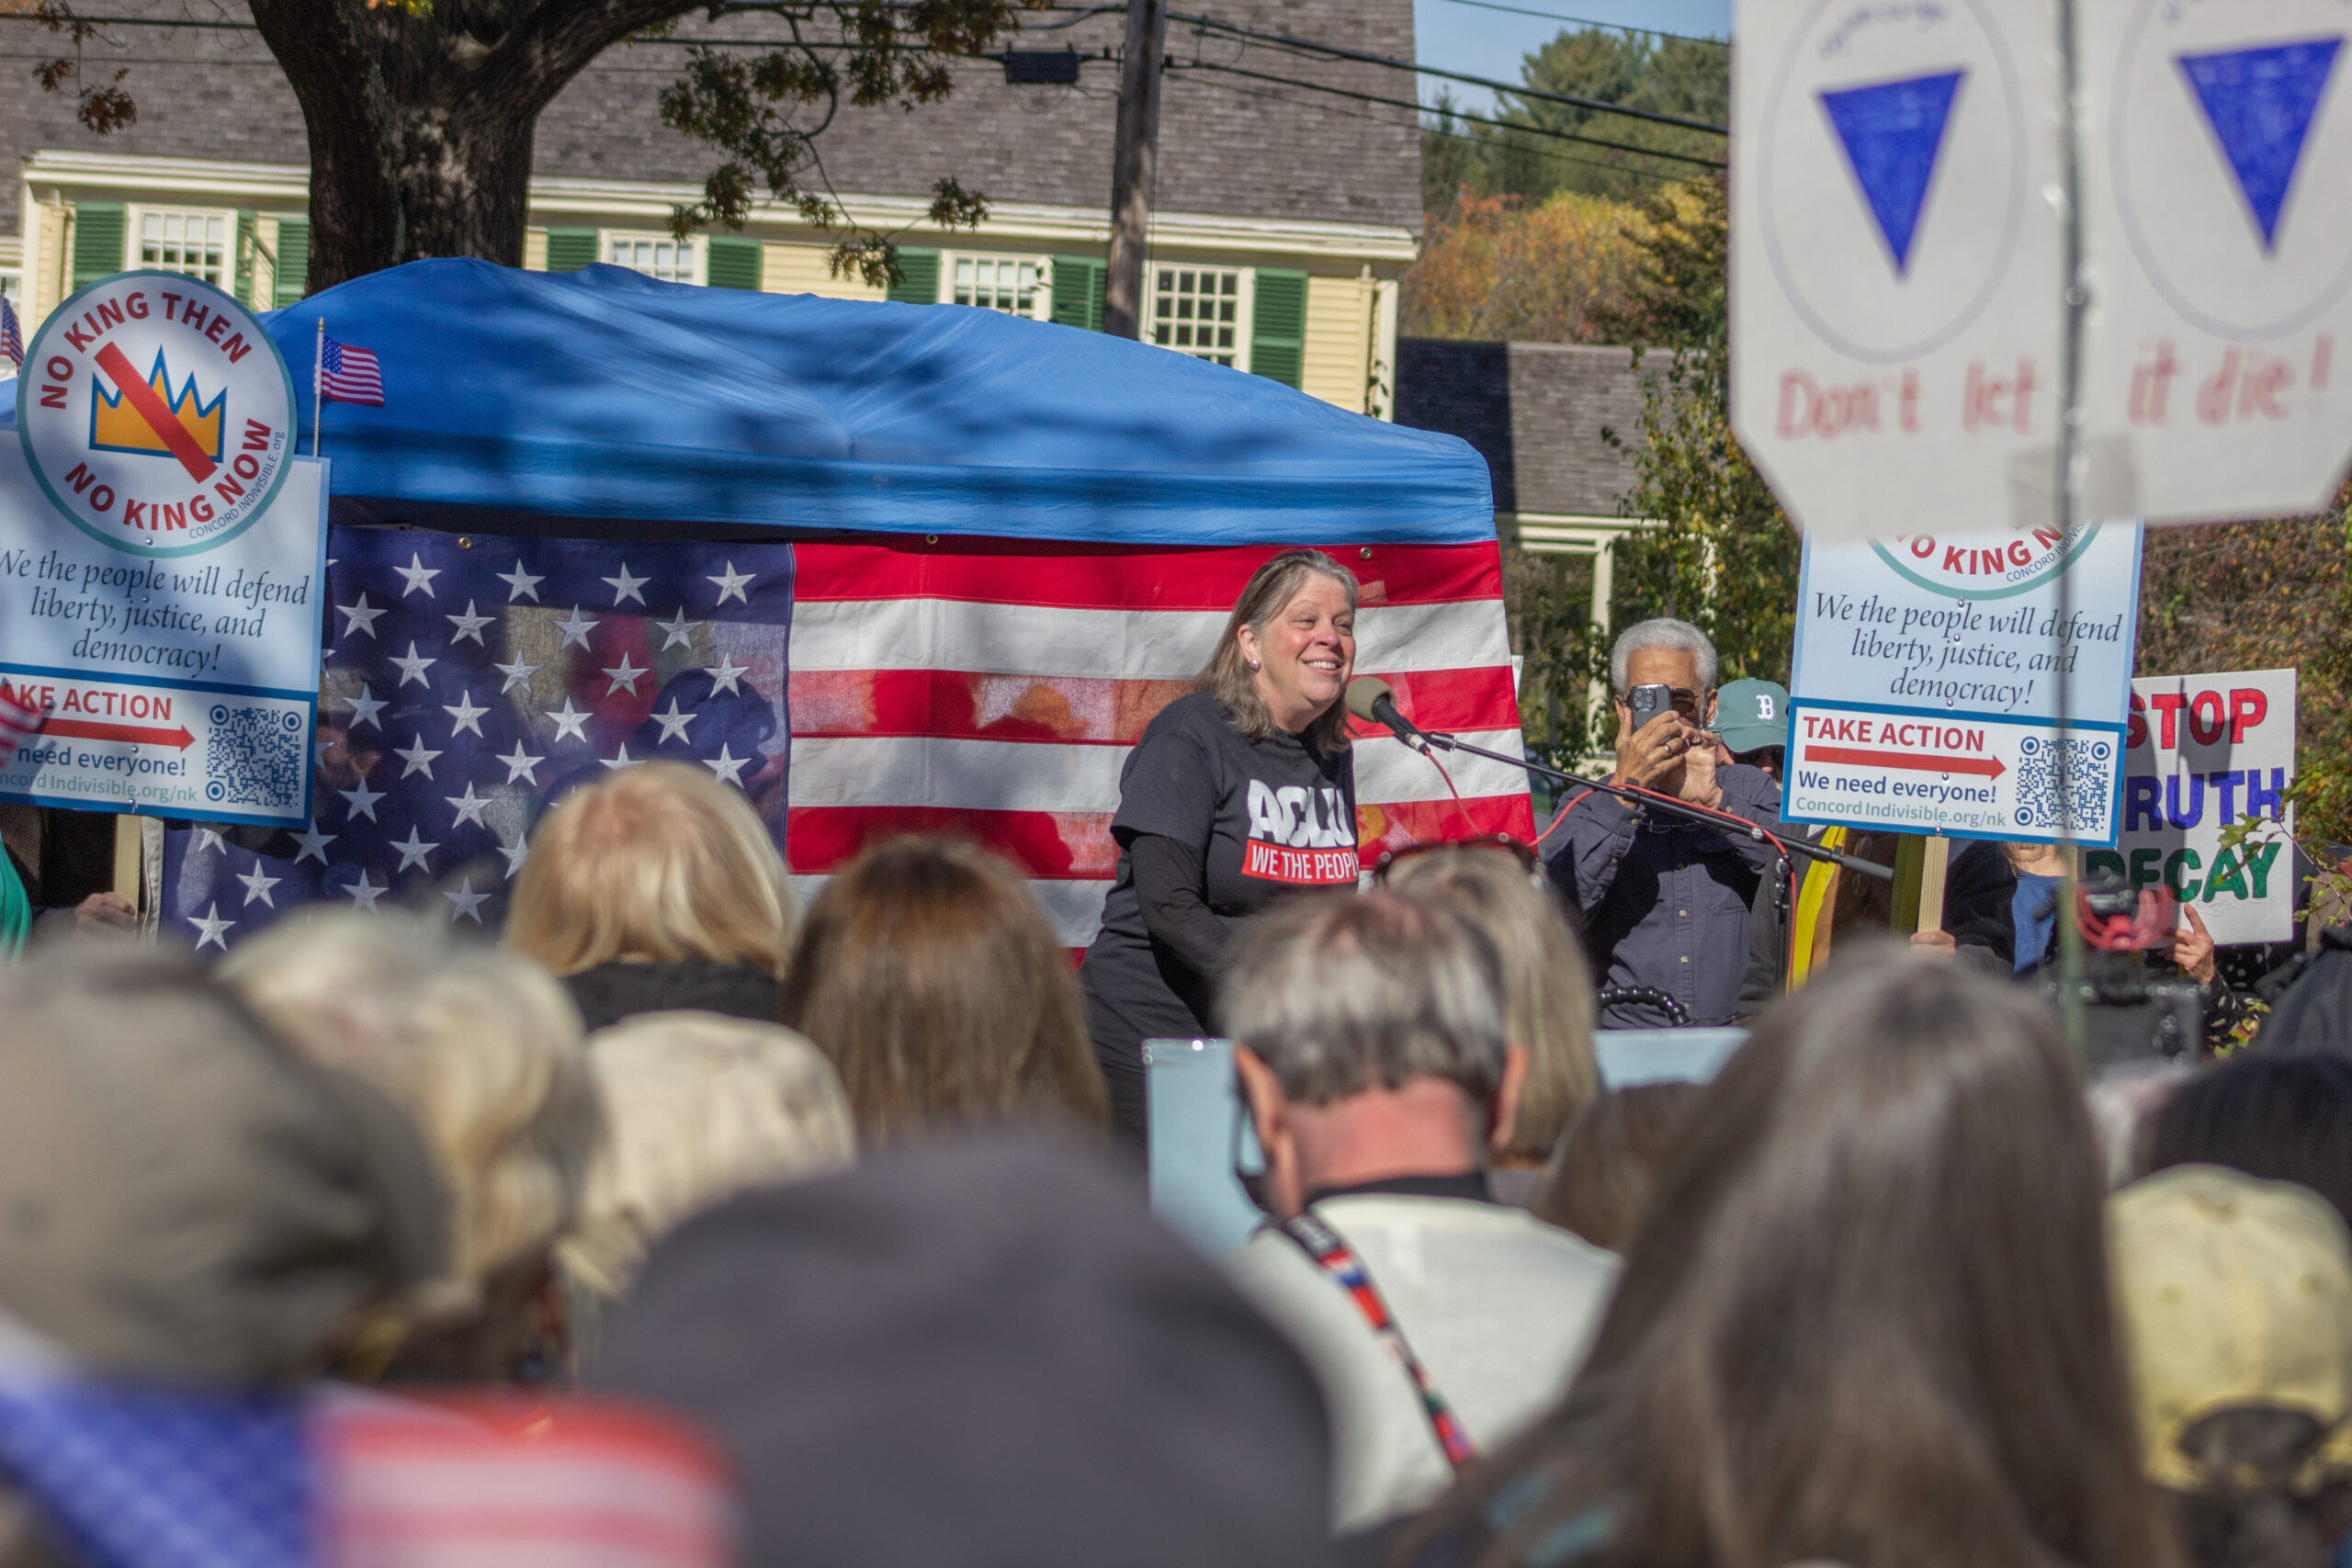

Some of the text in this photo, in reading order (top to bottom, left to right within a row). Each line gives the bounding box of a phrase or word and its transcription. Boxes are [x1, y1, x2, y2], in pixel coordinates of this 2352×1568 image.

[40, 292, 253, 410] NO KING THEN
[1962, 357, 2040, 436] let
[2127, 338, 2181, 429] it
[64, 418, 272, 531] NO KING NOW
[189, 508, 240, 539] CONCORD
[39, 549, 77, 582] the
[80, 559, 165, 598] people
[173, 566, 221, 595] will
[226, 568, 311, 611] defend
[1942, 540, 2032, 576] KING
[2007, 553, 2056, 583] CONCORD
[30, 586, 266, 638] liberty, justice, and
[1815, 592, 2123, 649] We the people will defend
[73, 628, 221, 679] democracy!
[1851, 628, 2078, 674] liberty, justice, and
[62, 688, 173, 721] ACTION
[1756, 694, 1776, 720] B
[1890, 667, 2034, 714] democracy!
[1804, 716, 1984, 752] TAKE ACTION
[18, 746, 187, 777] need everyone!
[0, 773, 198, 804] ncord Indivisible.org/nk
[1799, 770, 1996, 804] We need everyone!
[2121, 768, 2285, 832] RUTH
[1247, 779, 1356, 848] ACLU
[1251, 844, 1279, 875] WE
[1282, 851, 1313, 879] THE
